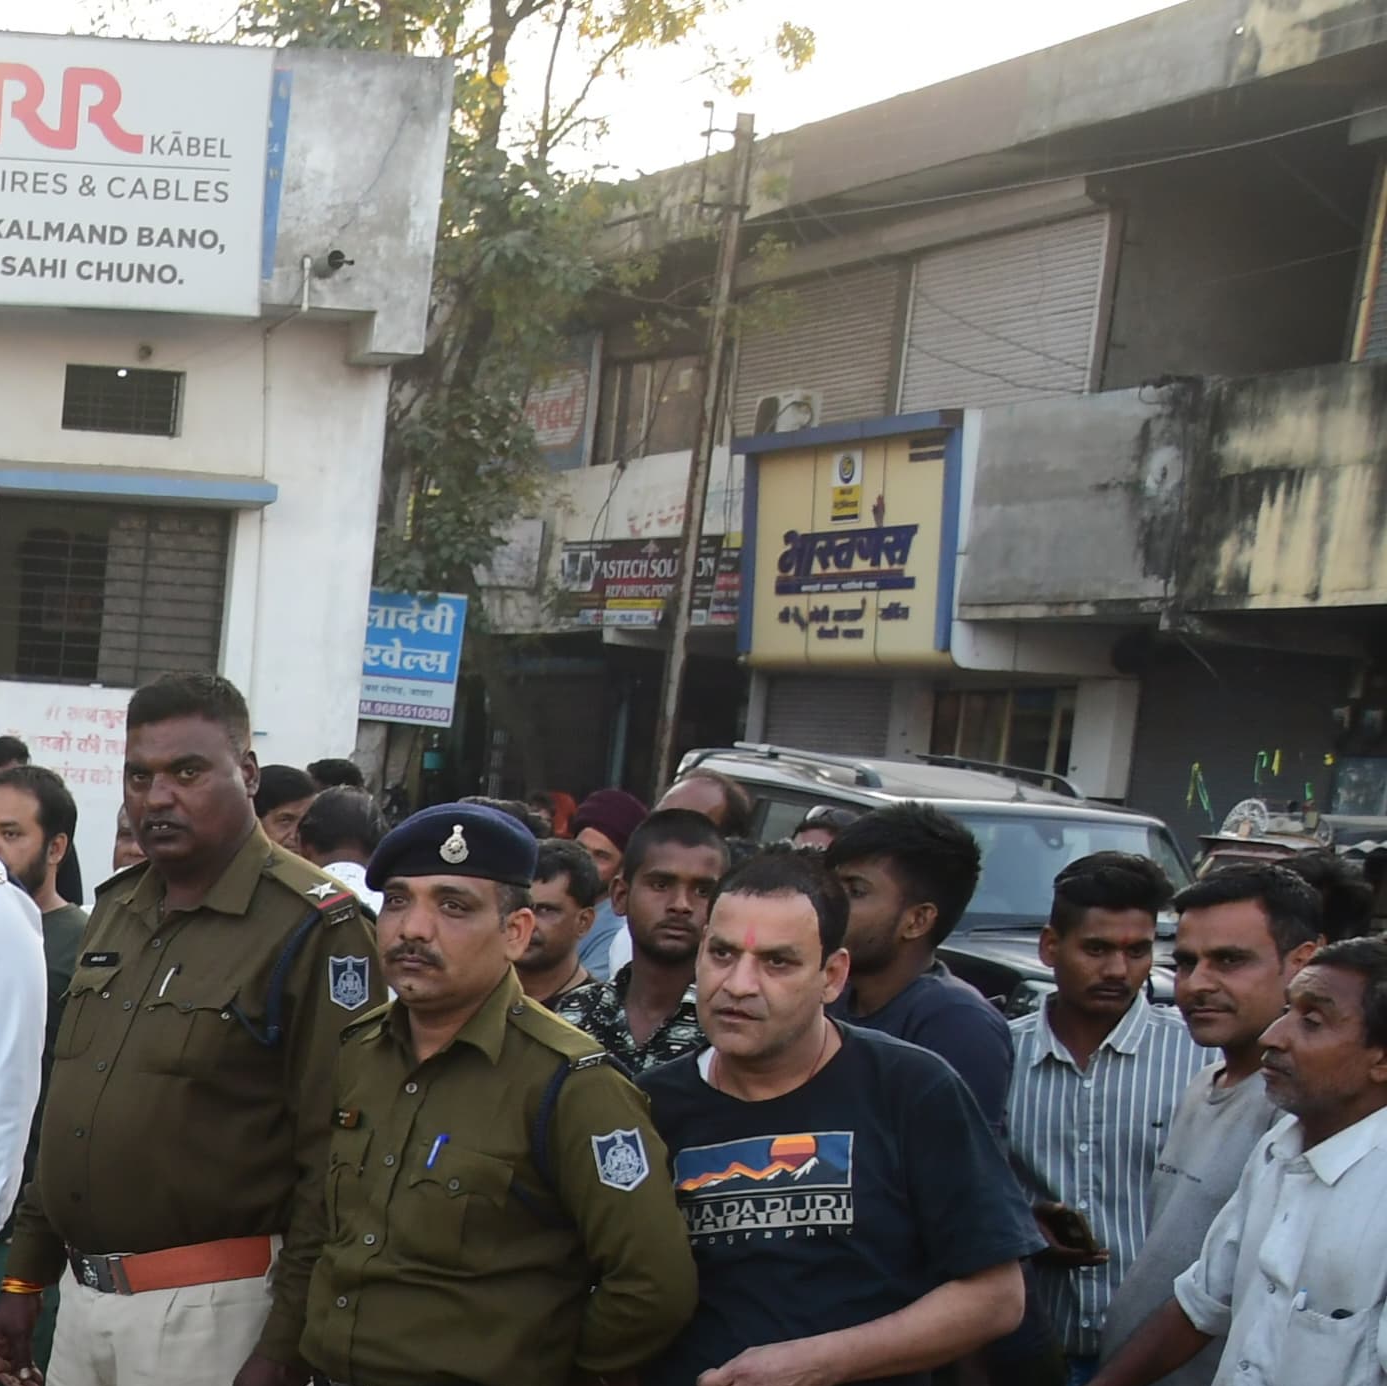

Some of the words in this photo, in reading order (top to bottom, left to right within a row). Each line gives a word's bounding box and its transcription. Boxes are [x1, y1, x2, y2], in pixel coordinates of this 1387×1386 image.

[150, 131, 232, 158] KĀBEL
[78, 175, 96, 197] &
[107, 176, 230, 203] CABLES
[136, 227, 226, 254] BANO,
[0, 256, 67, 280] SAHI
[76, 259, 184, 285] CHUNO.
